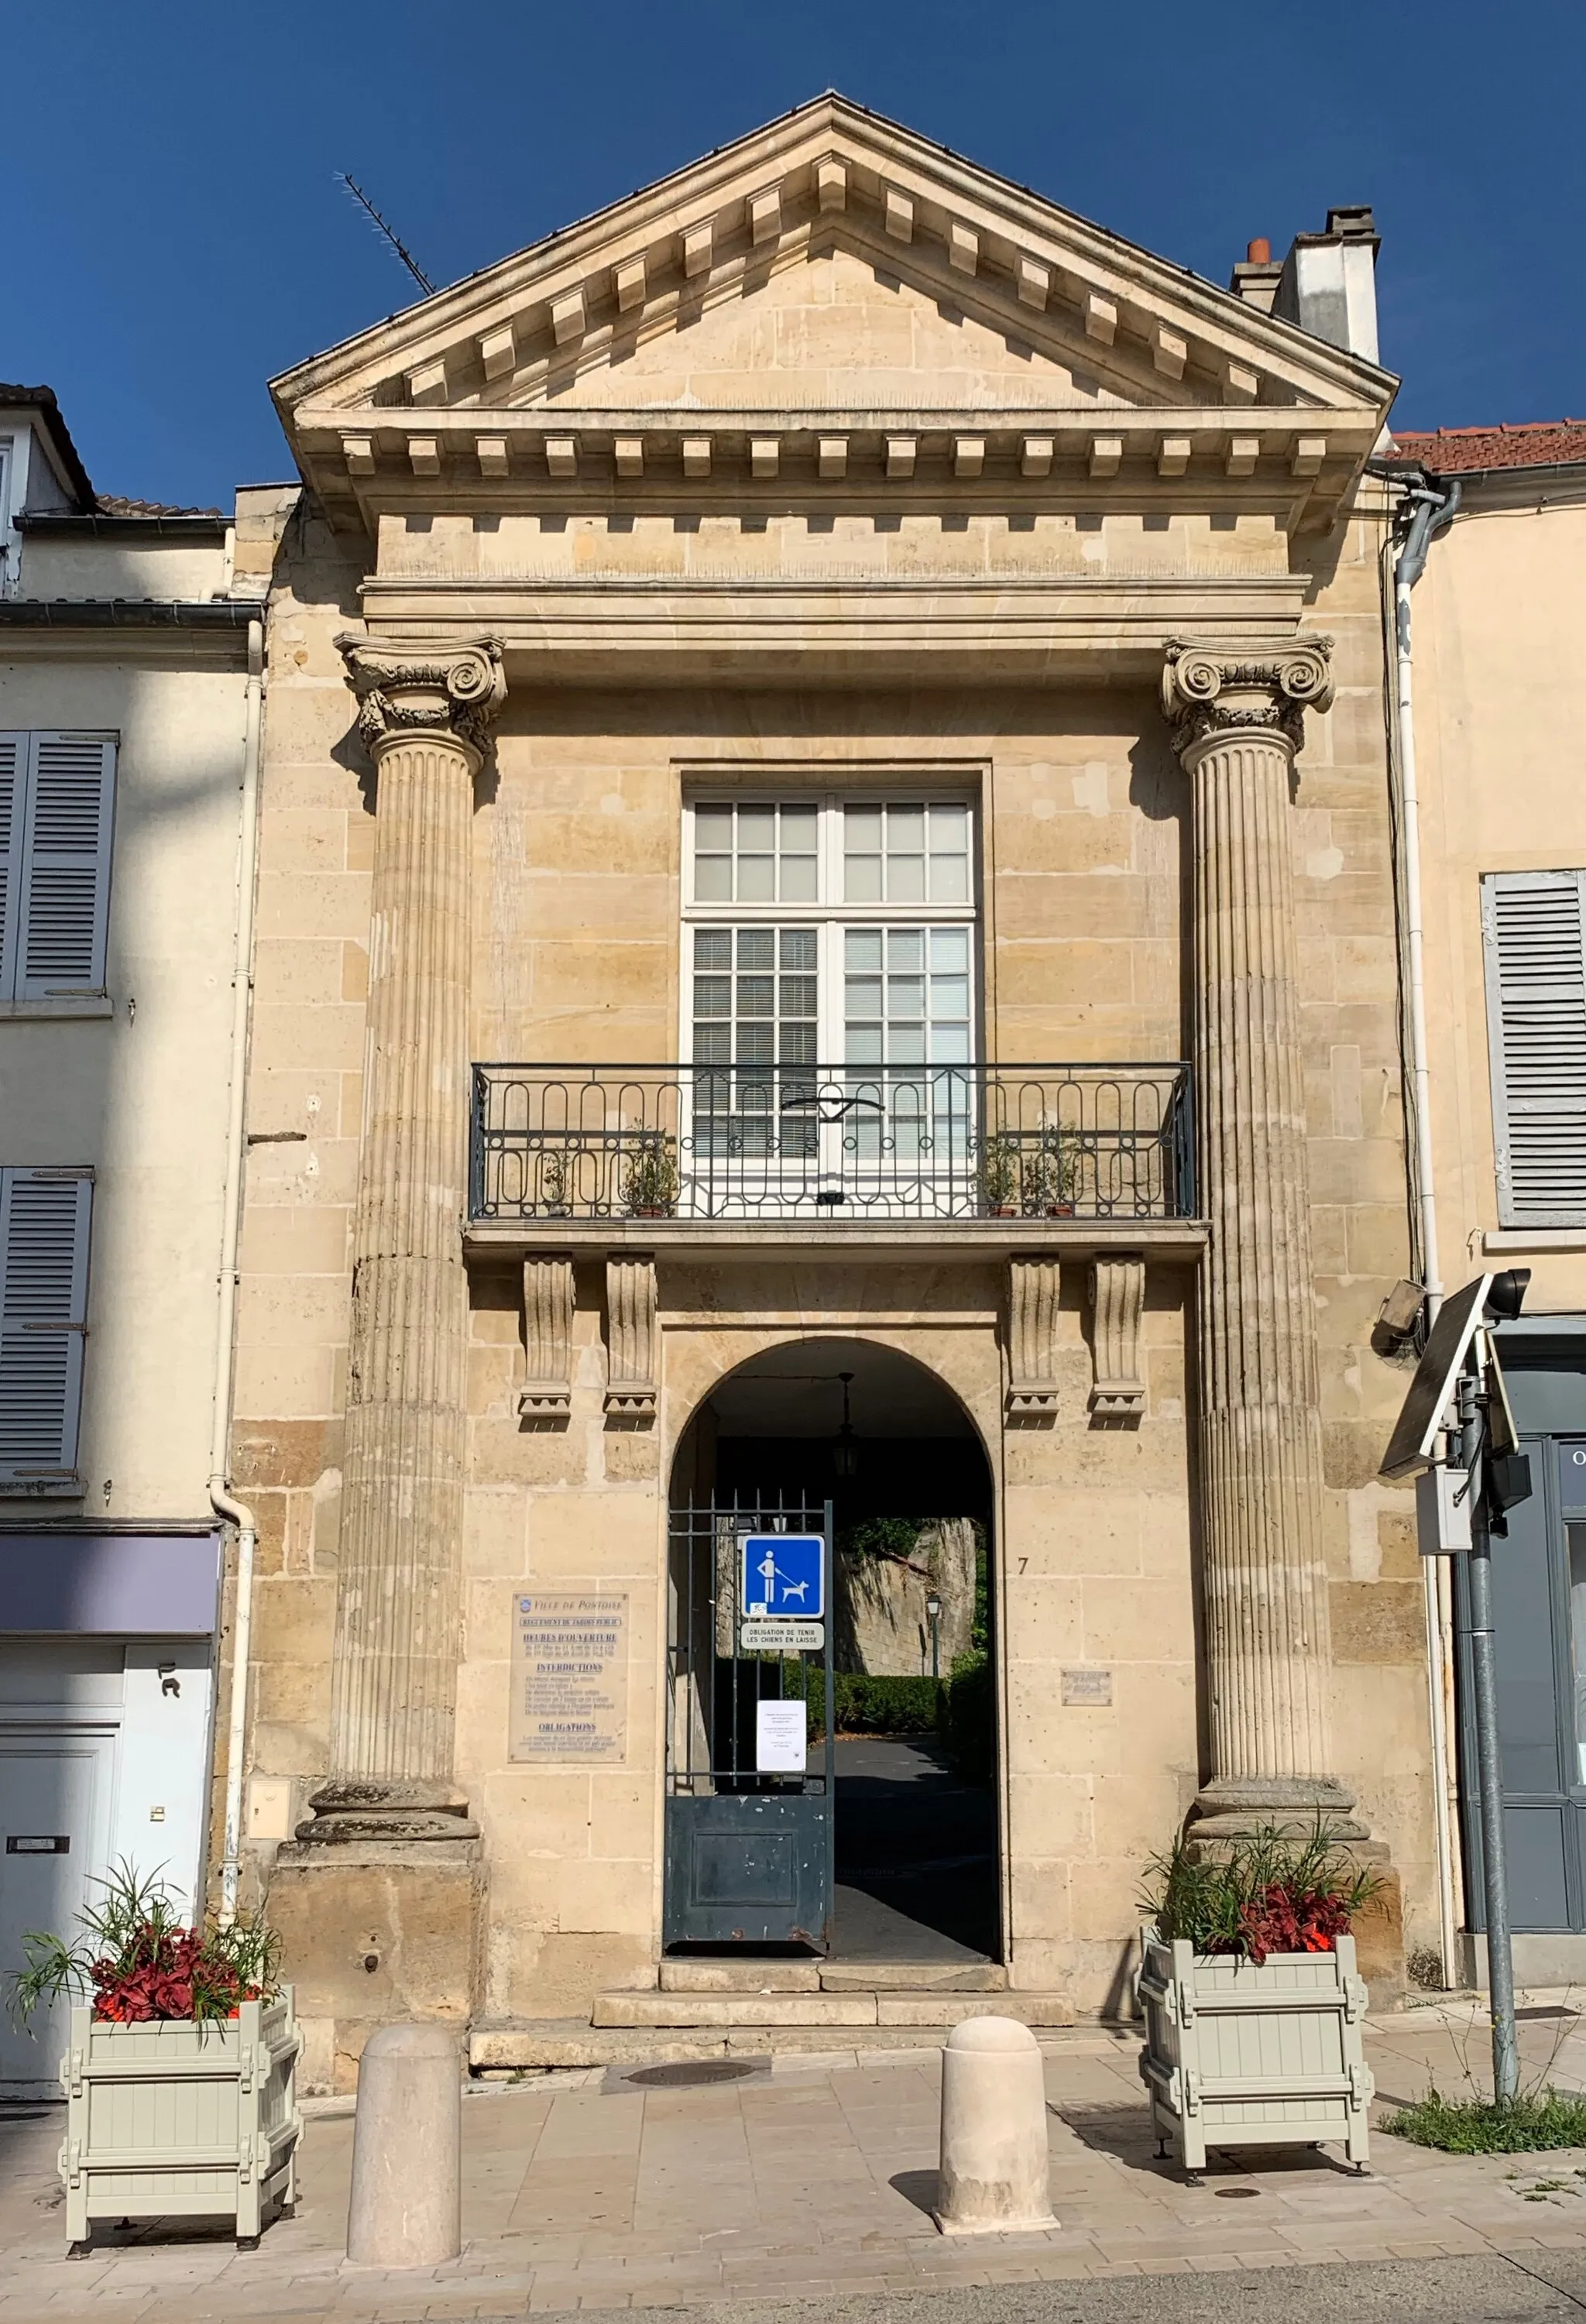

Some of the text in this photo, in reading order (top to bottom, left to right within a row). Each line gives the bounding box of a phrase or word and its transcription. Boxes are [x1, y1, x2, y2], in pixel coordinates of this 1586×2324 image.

[1018, 1557, 1029, 1575] 7
[523, 1633, 556, 1642] HEURES
[537, 1663, 603, 1673] INTERDICTIONS
[538, 1722, 596, 1732] OBLIGATIONS
